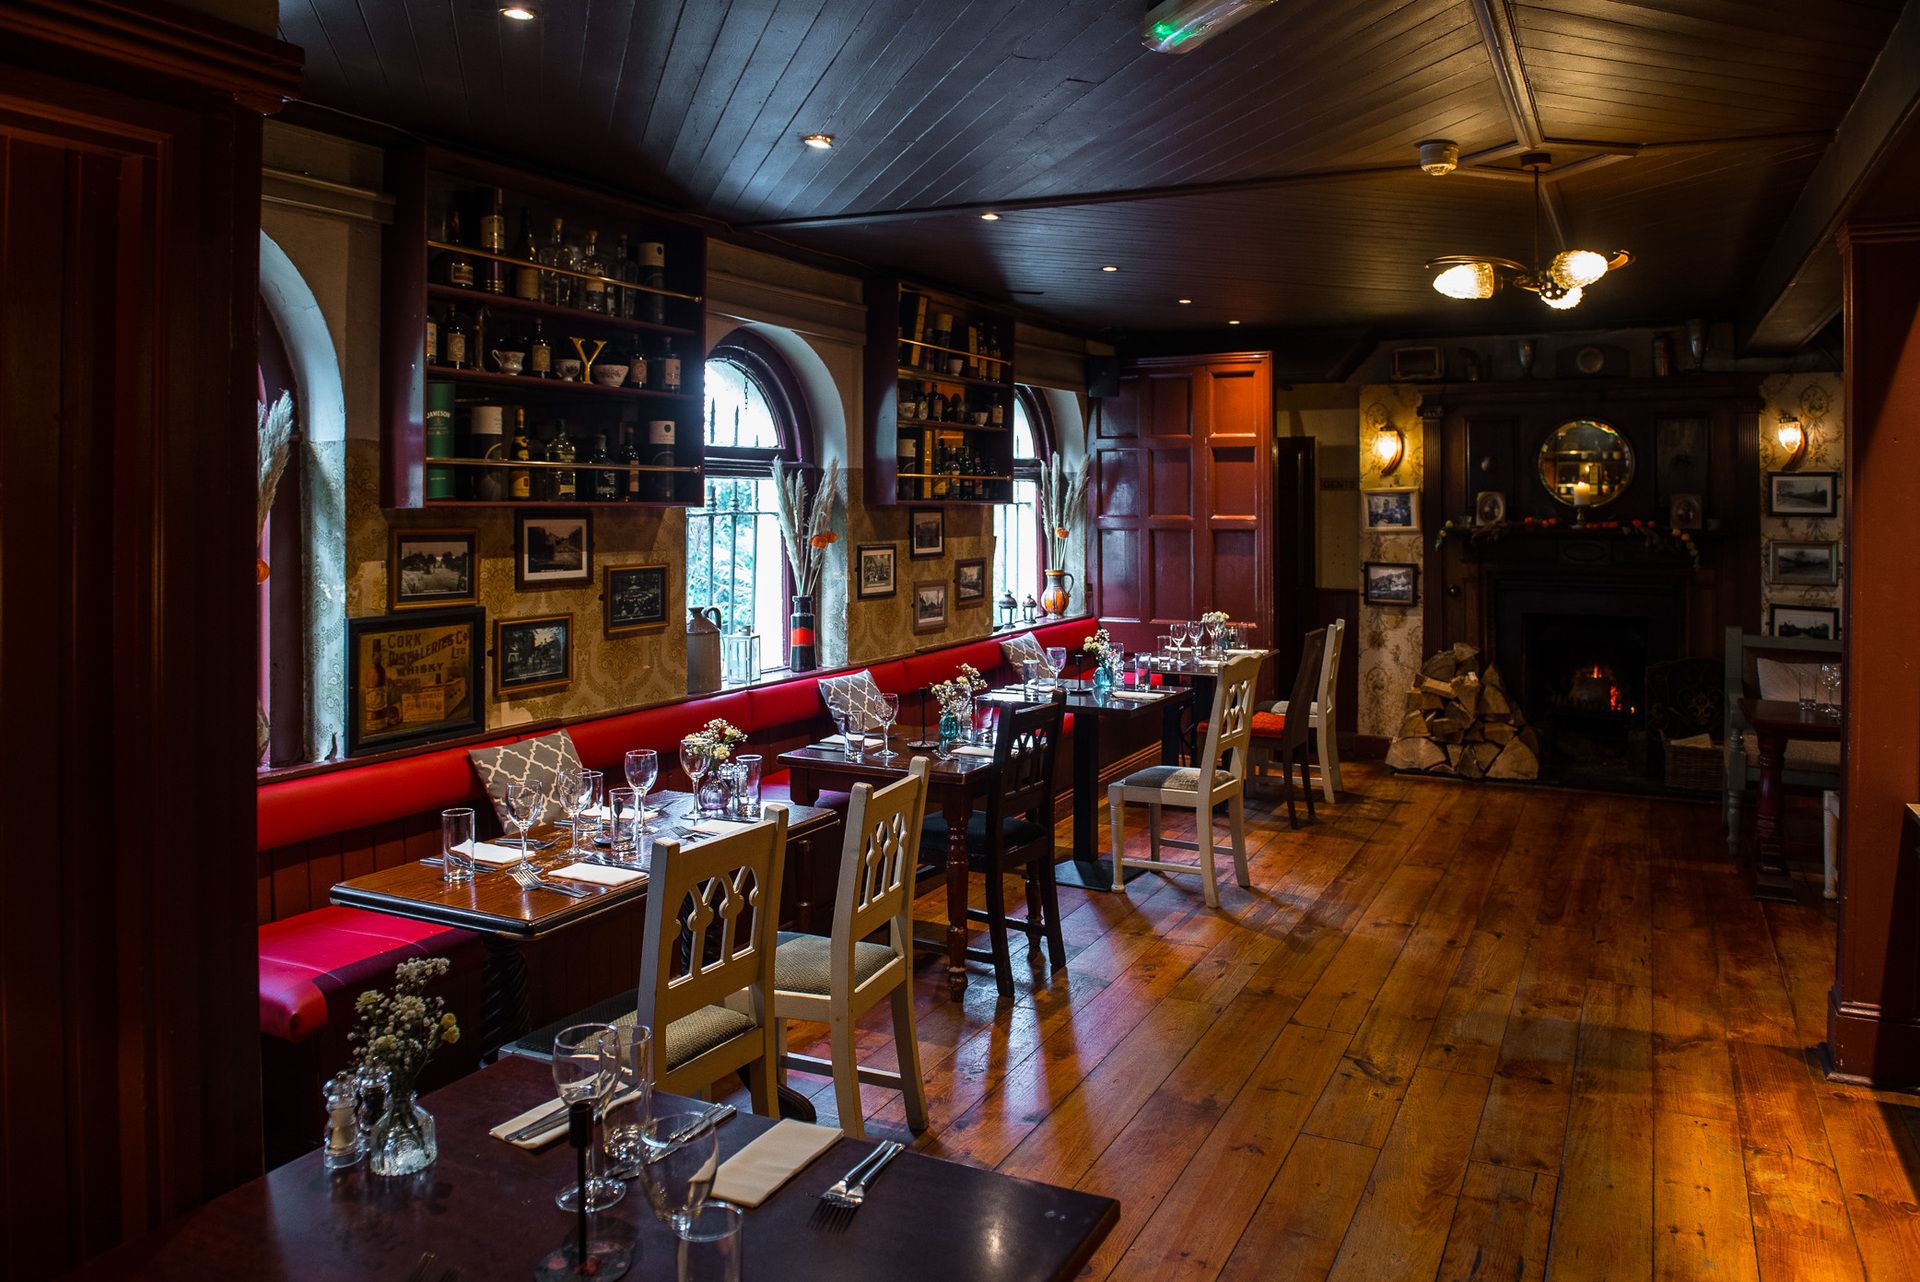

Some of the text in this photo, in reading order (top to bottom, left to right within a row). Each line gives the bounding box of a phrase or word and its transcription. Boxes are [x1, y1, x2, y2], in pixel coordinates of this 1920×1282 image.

[569, 336, 607, 385] Y
[427, 410, 452, 419] JAMESON
[388, 633, 421, 648] CORK
[397, 662, 444, 677] WHISKY
